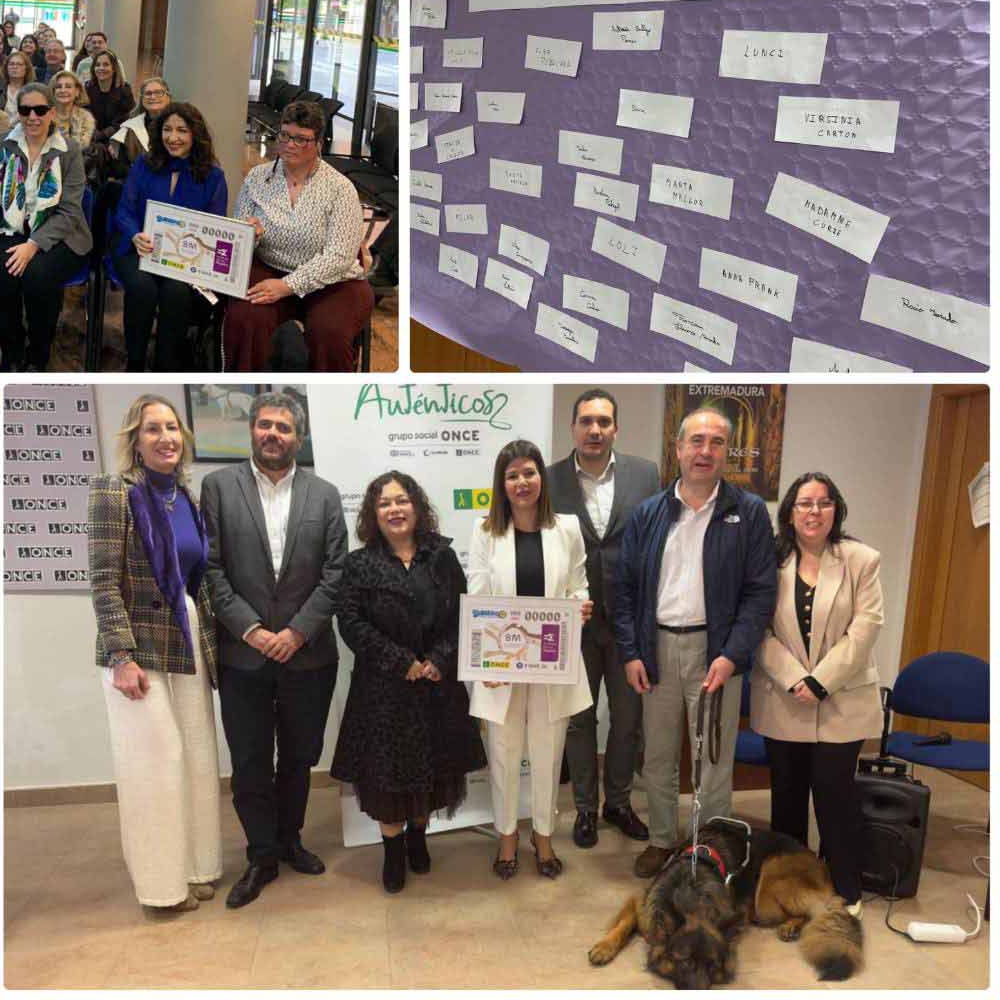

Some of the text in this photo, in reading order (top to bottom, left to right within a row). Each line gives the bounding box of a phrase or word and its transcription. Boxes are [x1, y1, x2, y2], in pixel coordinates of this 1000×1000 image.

[202, 226, 235, 240] 00000
[688, 384, 766, 397] EXTREMADURA
[12, 400, 55, 411] ONCE
[49, 424, 92, 436] ONCE
[388, 430, 480, 444] grupo social ONCE
[18, 450, 61, 461] ONCE
[23, 499, 67, 510] ONCE
[30, 547, 72, 558] ONCE
[525, 611, 561, 622] 00000
